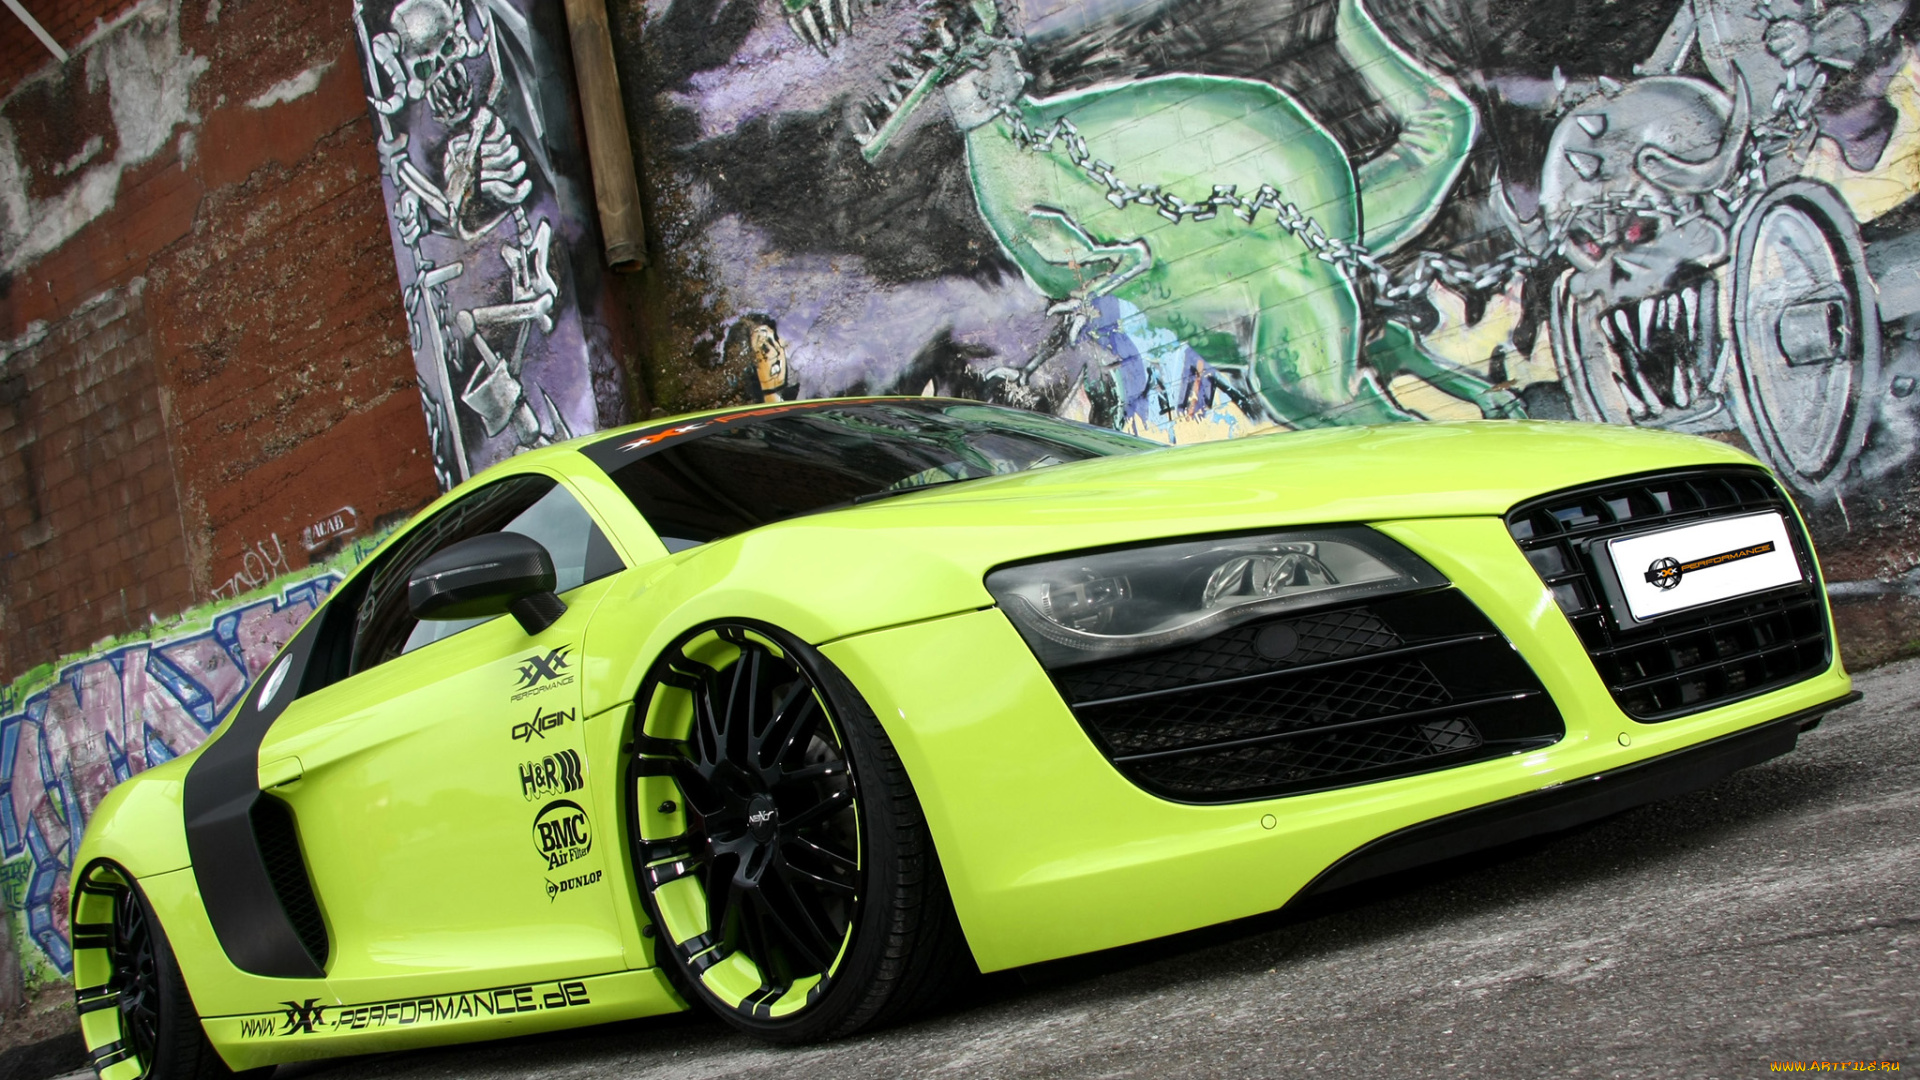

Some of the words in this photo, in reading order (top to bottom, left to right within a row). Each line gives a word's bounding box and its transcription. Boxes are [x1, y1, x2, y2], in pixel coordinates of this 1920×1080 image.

[312, 514, 344, 538] ACAB
[1681, 544, 1771, 571] PERFORMANCE
[510, 675, 575, 703] PERFORMANCE
[511, 707, 576, 743] OXIGIN
[519, 757, 559, 796] H&R
[537, 813, 588, 853] BMC
[547, 849, 569, 871] Air
[568, 846, 589, 862] Filter
[559, 869, 603, 893] DUNLOP
